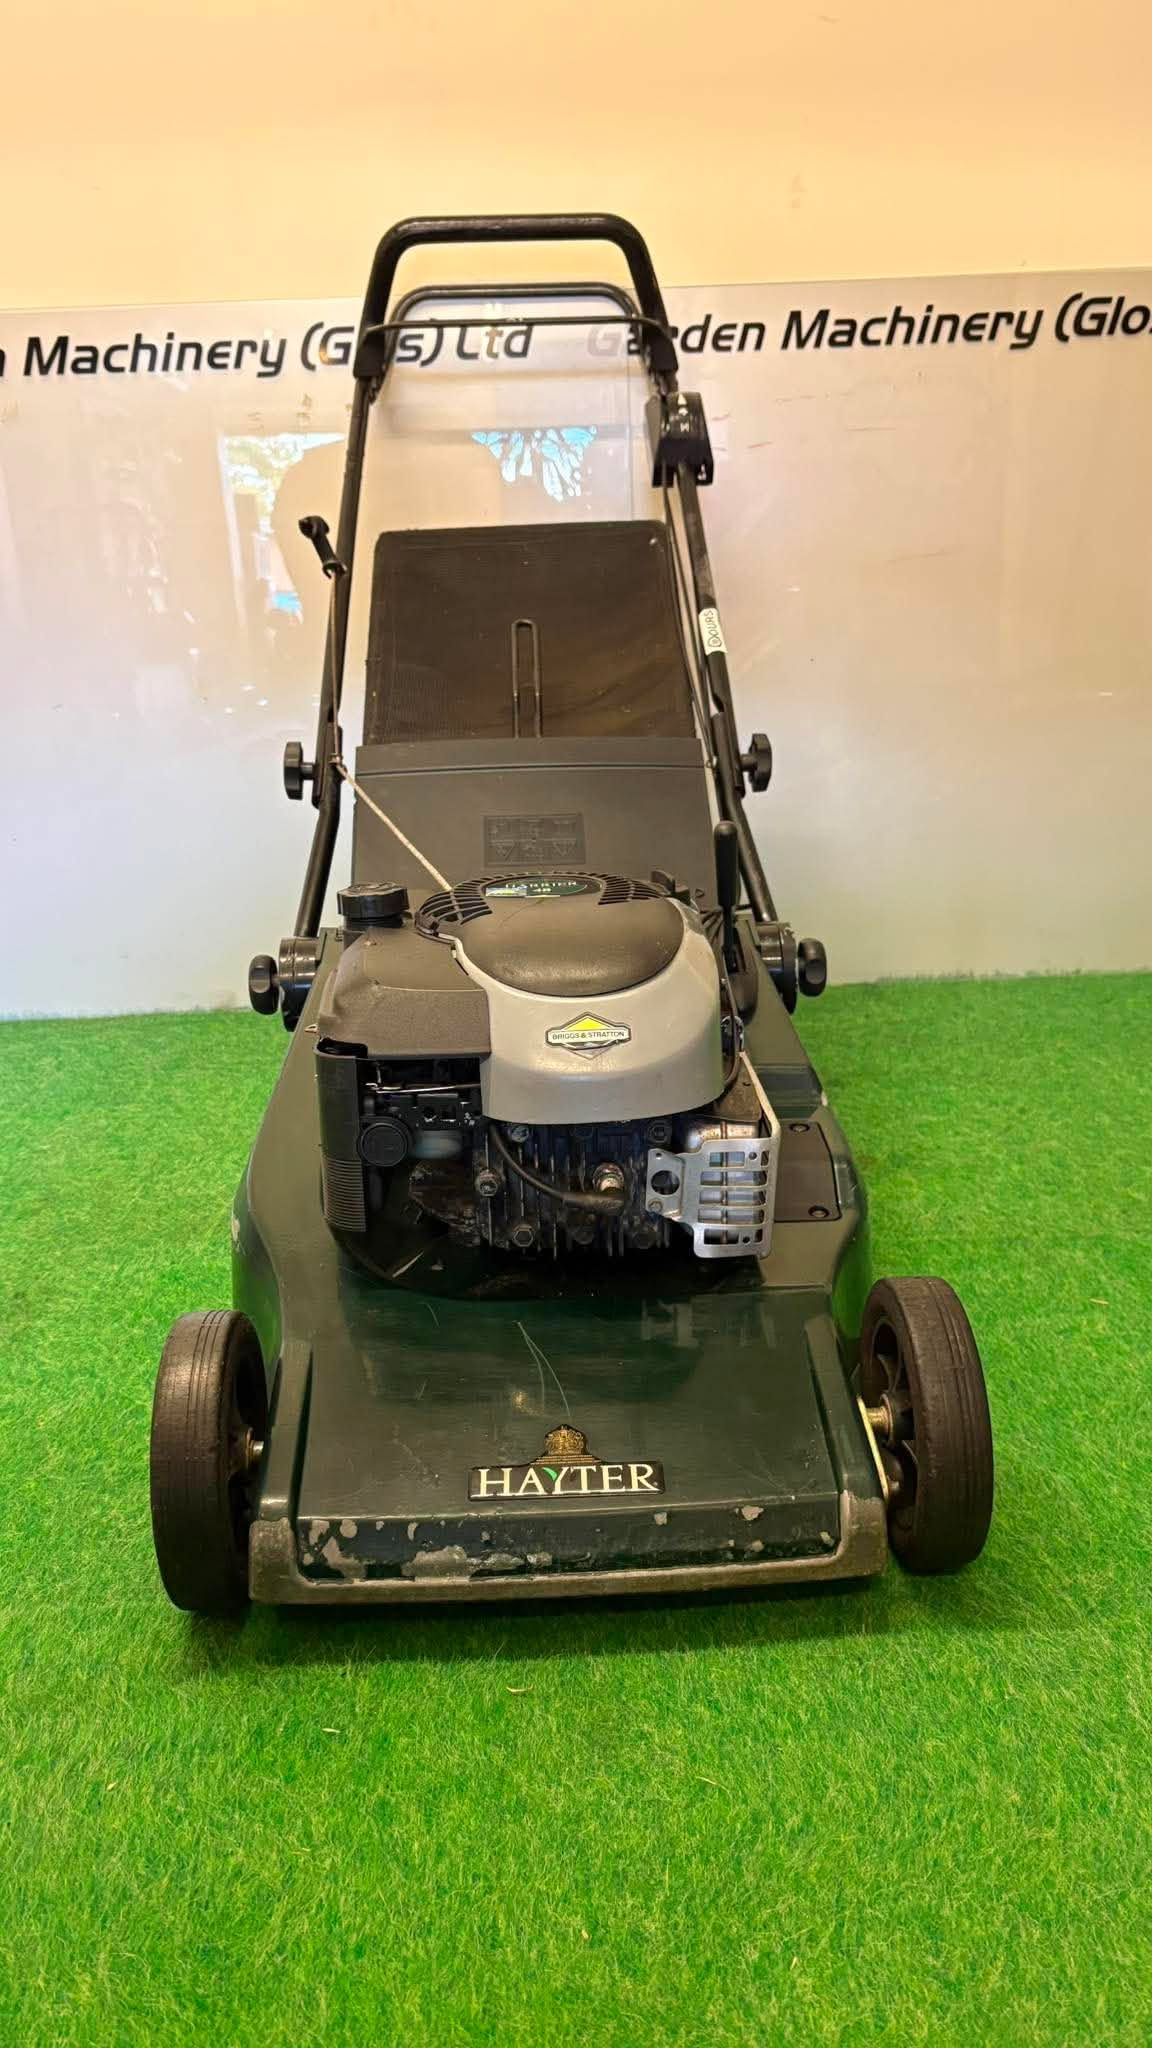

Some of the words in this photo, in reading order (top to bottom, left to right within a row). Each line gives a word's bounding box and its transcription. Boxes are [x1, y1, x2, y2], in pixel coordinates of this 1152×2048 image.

[587, 314, 766, 357] Gaden
[781, 304, 1043, 350] Machinery
[1055, 291, 1152, 343] (Glo
[23, 330, 287, 378] Machinery
[300, 322, 444, 370] (Gs)
[456, 325, 533, 360] Ltd
[552, 1033, 580, 1041] BRIGGS
[588, 1031, 625, 1039] STRATTON
[478, 1463, 660, 1497] HAYTER
